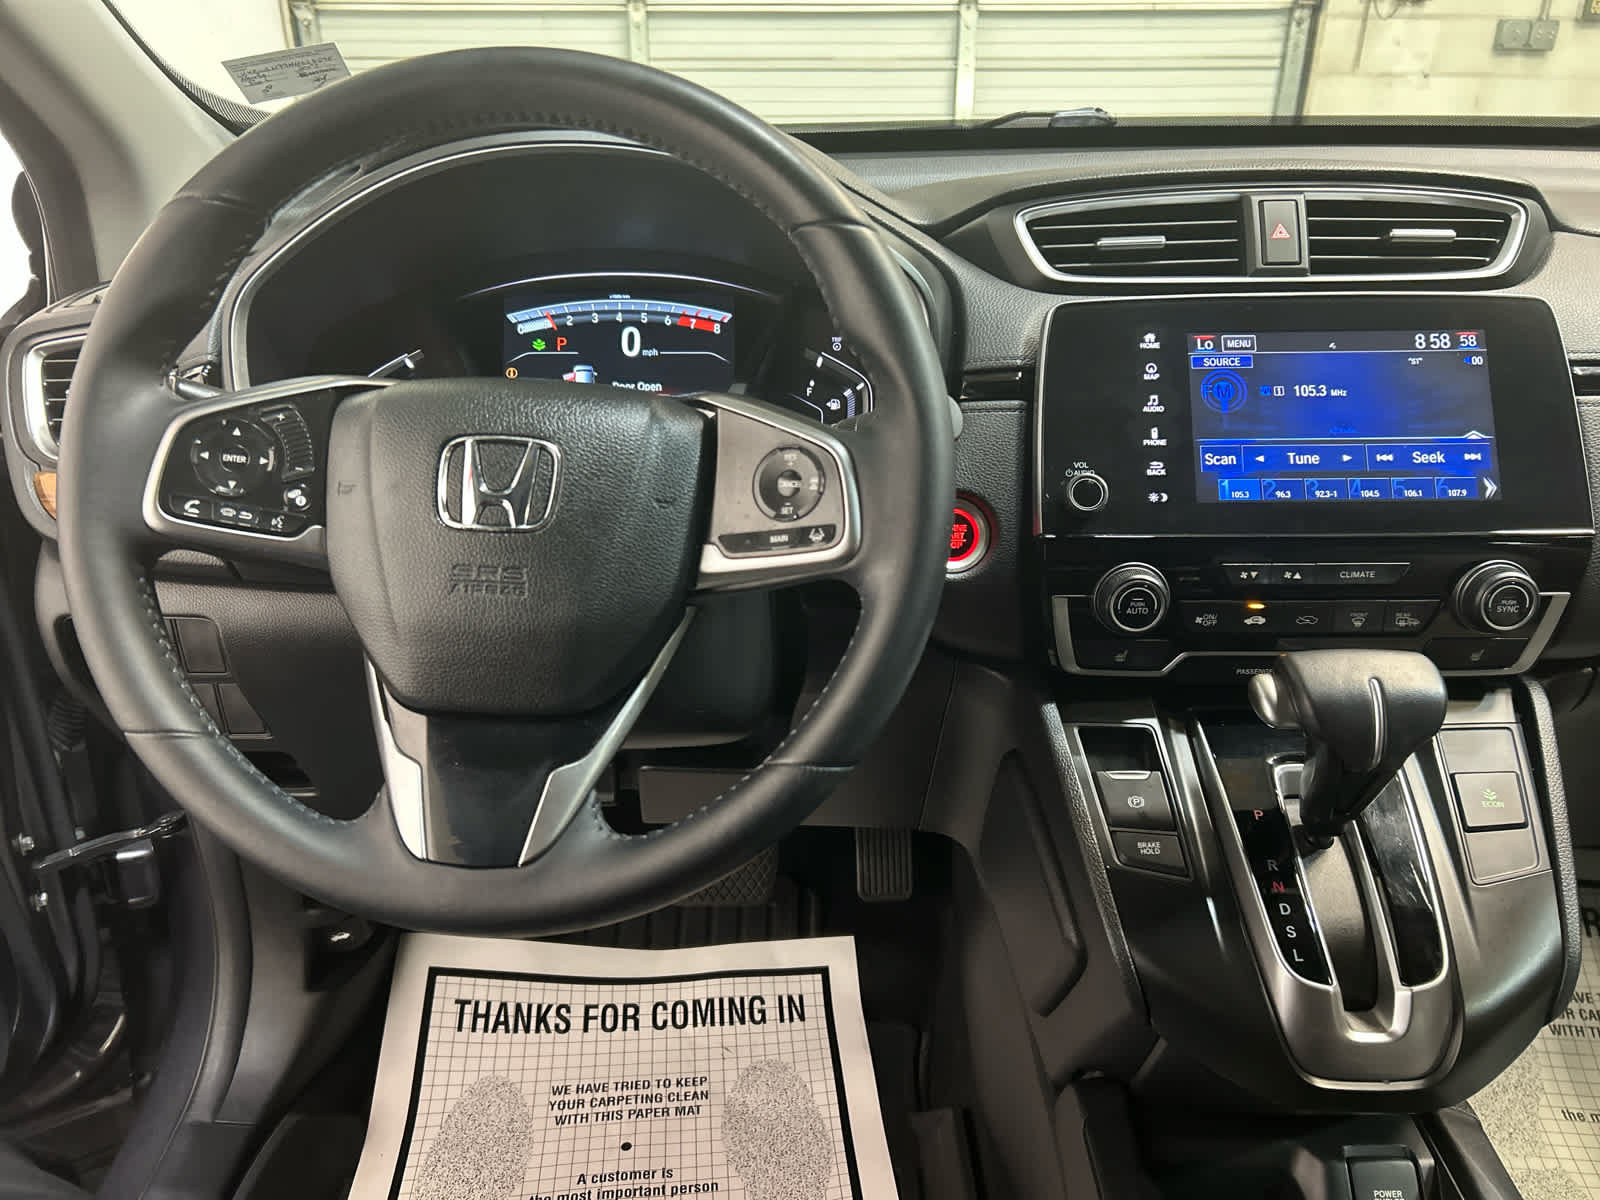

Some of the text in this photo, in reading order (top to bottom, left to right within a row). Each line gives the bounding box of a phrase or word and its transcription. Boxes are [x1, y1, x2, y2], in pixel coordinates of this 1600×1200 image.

[566, 315, 573, 326] 2
[591, 312, 599, 323] 3
[615, 311, 623, 322] 4
[640, 312, 648, 323] 5
[664, 315, 672, 326] 6
[690, 318, 697, 329] 7
[713, 322, 721, 334] 8
[556, 336, 568, 351] P
[621, 326, 659, 357] 0 mph
[1197, 338, 1214, 350] Lo
[1227, 340, 1252, 348] MENU
[1460, 335, 1477, 347] 58
[1203, 357, 1241, 367] SOURCE
[1471, 356, 1484, 365] 00
[637, 381, 663, 392] Open
[806, 387, 813, 397] F
[1294, 385, 1327, 397] 105.3
[1330, 388, 1348, 397] MHz
[222, 454, 248, 464] ENTER
[1204, 451, 1446, 465] Scan Tune Seek
[1146, 468, 1167, 476] BACK
[1275, 490, 1292, 498] 96.3
[1360, 490, 1380, 498] 104.5
[1403, 490, 1423, 498] 106.1
[1447, 489, 1467, 498] 107.9
[1339, 571, 1376, 579] CLIMATE
[1126, 607, 1149, 615] AUTO
[1496, 605, 1520, 614] SYNC
[1253, 809, 1264, 821] P
[1137, 841, 1161, 849] BRAKE
[1266, 859, 1279, 872] R
[1272, 881, 1286, 894] N
[1279, 903, 1292, 916] D
[1286, 925, 1297, 939] S
[1292, 949, 1304, 962] L
[455, 994, 806, 1034] THANKS FOR COMING IN
[1548, 1024, 1585, 1037] WITH
[551, 1076, 708, 1096] WE HAVE TRIED TO KEEP
[549, 1090, 709, 1111] YOUR CARPETING CLEAN
[555, 1105, 702, 1126] WITH THIS PAPER MAT
[1561, 1108, 1585, 1122] the
[577, 1167, 674, 1185] A customer is
[557, 1190, 592, 1200] most
[597, 1184, 666, 1200] important
[670, 1182, 720, 1198] person
[1373, 1190, 1403, 1198] POWER
